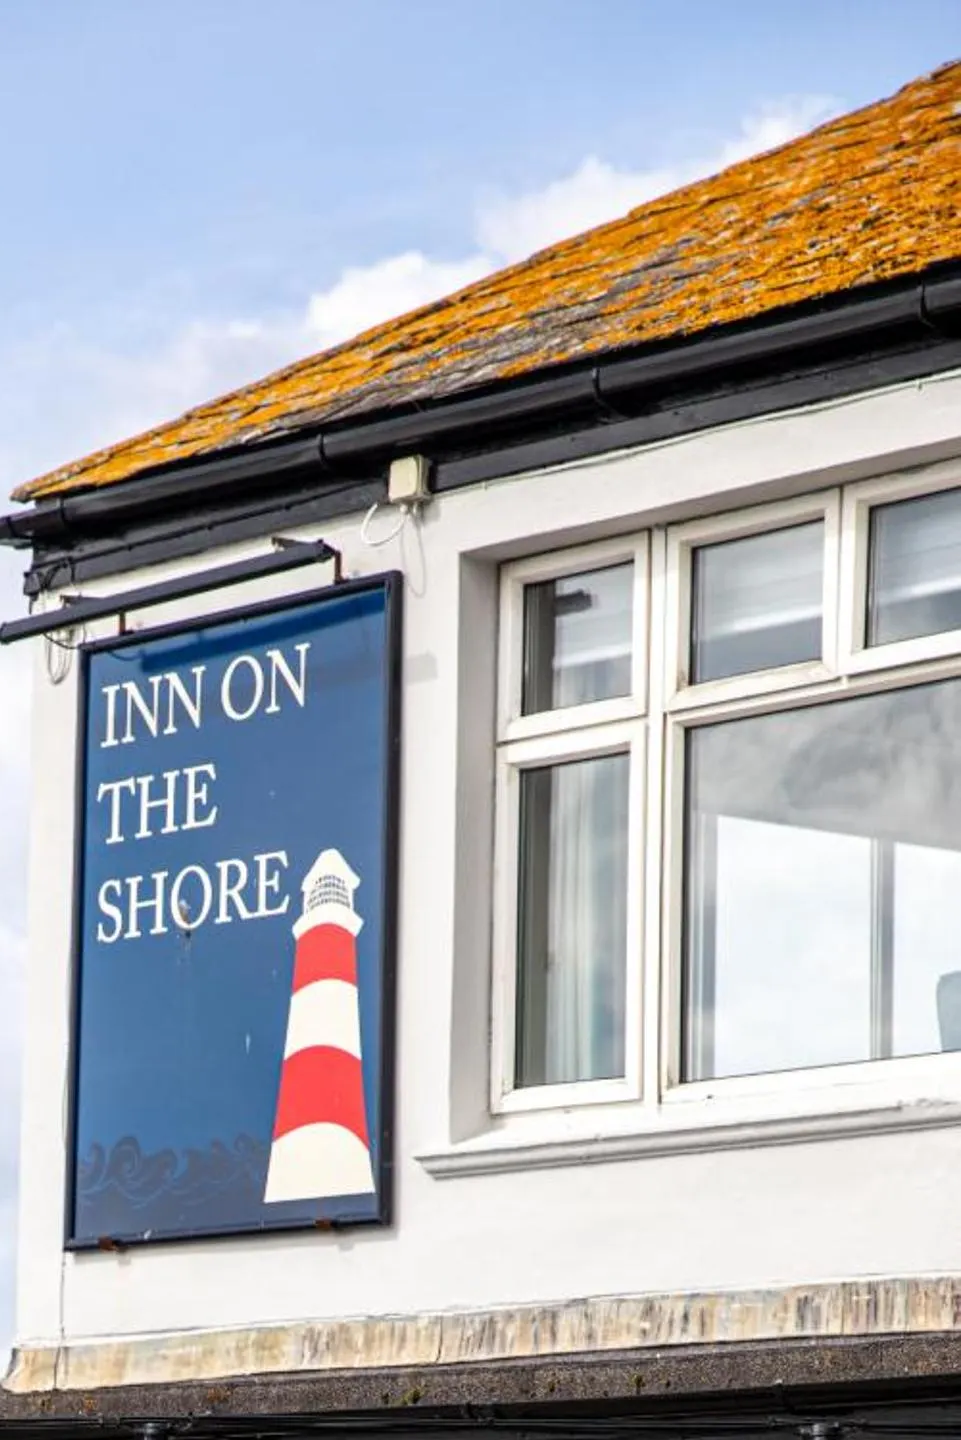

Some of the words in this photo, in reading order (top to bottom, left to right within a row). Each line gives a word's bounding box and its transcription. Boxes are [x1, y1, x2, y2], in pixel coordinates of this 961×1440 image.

[100, 665, 206, 748] INN
[221, 642, 310, 721] ON
[97, 763, 217, 844] THE
[97, 850, 290, 943] SHORE
